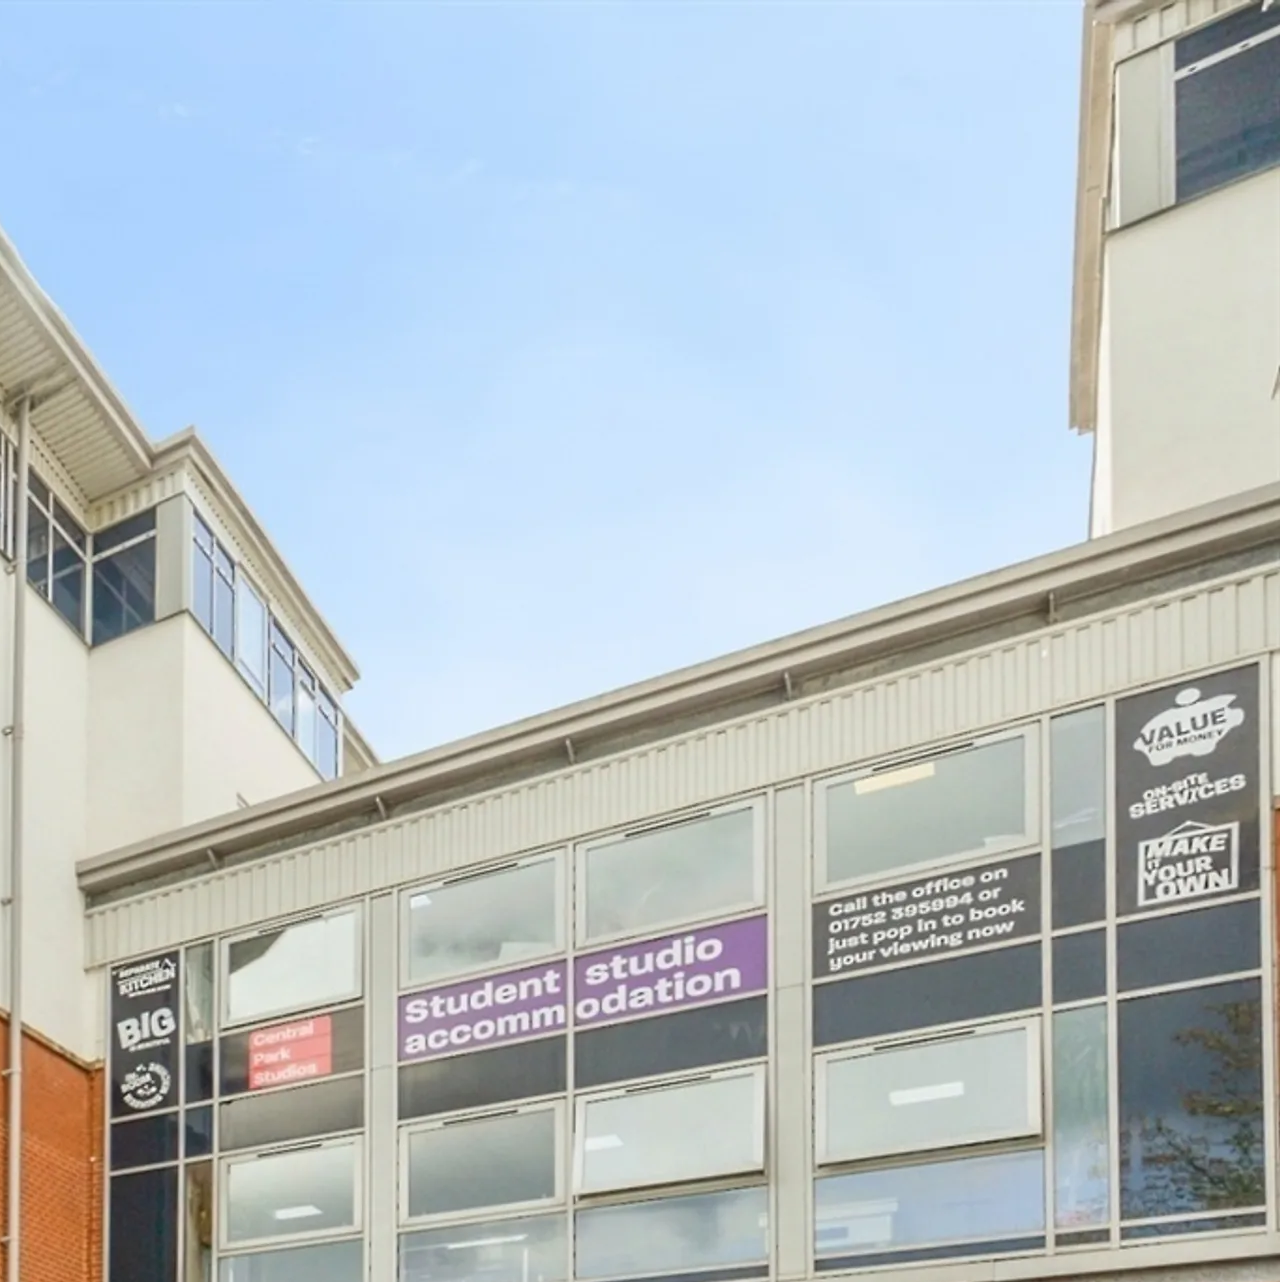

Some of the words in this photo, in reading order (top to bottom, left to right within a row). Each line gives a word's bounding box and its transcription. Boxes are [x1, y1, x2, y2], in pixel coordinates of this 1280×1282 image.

[1140, 707, 1228, 746] VALUE
[1148, 741, 1173, 754] FOR
[1176, 728, 1224, 747] MONEY
[1129, 774, 1247, 819] SERVICES
[1143, 772, 1208, 801] ON-SITE
[1146, 832, 1229, 860] MAKE
[1143, 855, 1213, 886] YOUR
[1155, 868, 1229, 900] OWN
[828, 896, 867, 917] Call
[872, 889, 907, 907] the
[911, 874, 976, 898] office
[979, 867, 1009, 884] on
[829, 911, 887, 934] 01752
[891, 891, 974, 921] 395994
[978, 886, 1002, 901] or
[827, 932, 869, 955] just
[873, 923, 913, 945] pop
[917, 917, 938, 933] in
[941, 912, 965, 928] to
[969, 898, 1026, 922] book
[829, 948, 876, 971] your
[879, 931, 963, 959] viewing
[966, 920, 1016, 941] now
[119, 965, 176, 996] KITCHEN
[404, 969, 561, 1024] Student
[585, 935, 723, 986] studio
[117, 1007, 177, 1050] BIG
[253, 1021, 315, 1047] Central
[254, 1046, 292, 1067] Park
[254, 1063, 318, 1086] Studios
